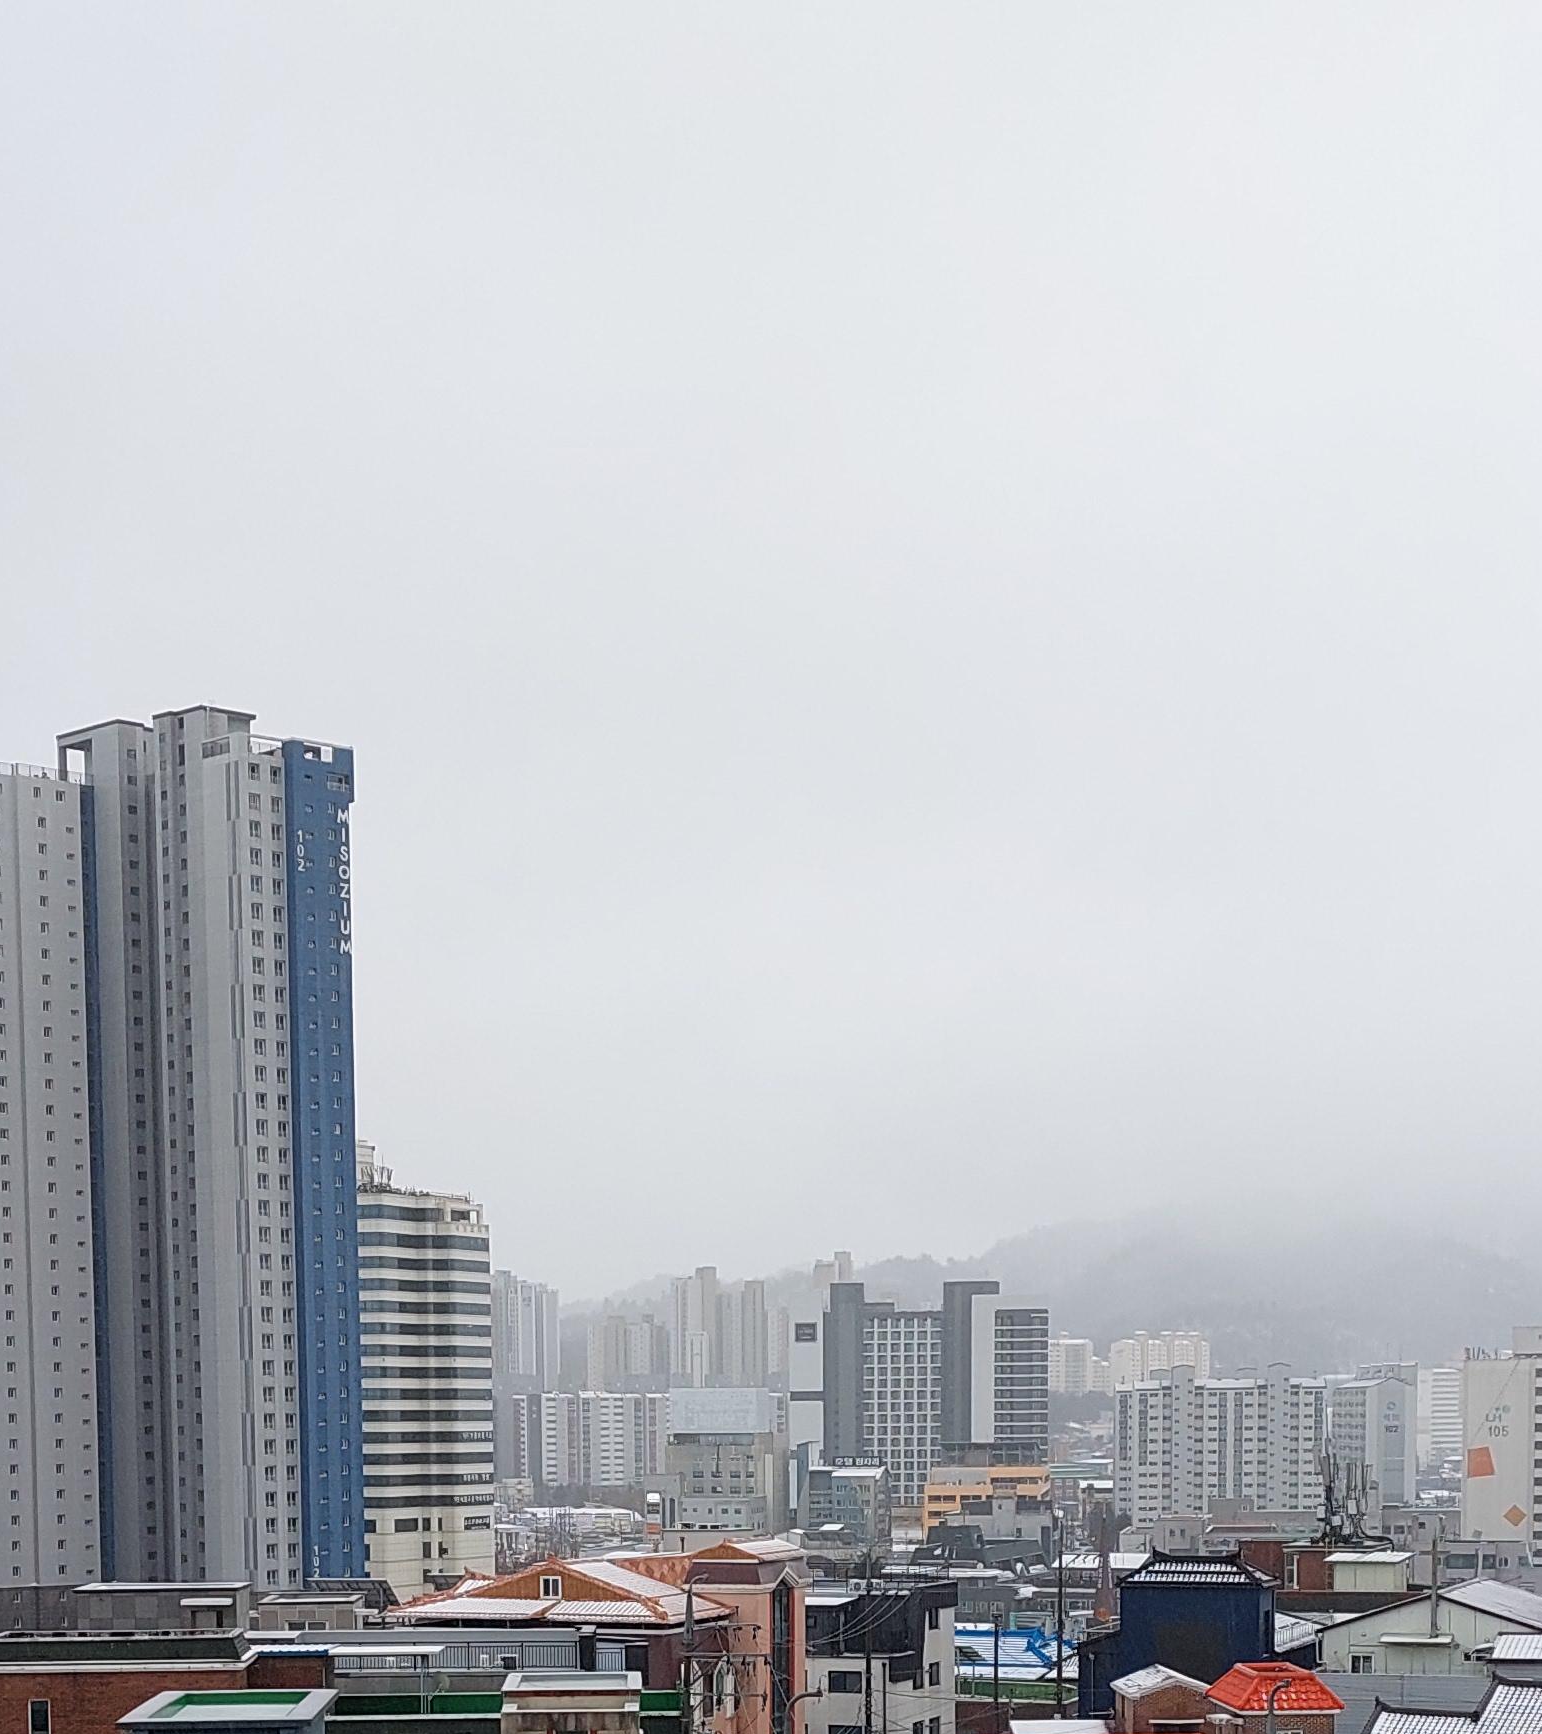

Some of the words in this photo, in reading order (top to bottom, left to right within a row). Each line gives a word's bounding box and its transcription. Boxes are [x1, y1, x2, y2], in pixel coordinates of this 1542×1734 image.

[297, 829, 306, 872] 102
[337, 808, 352, 955] MISOZIUM
[1488, 1426, 1509, 1437] 105
